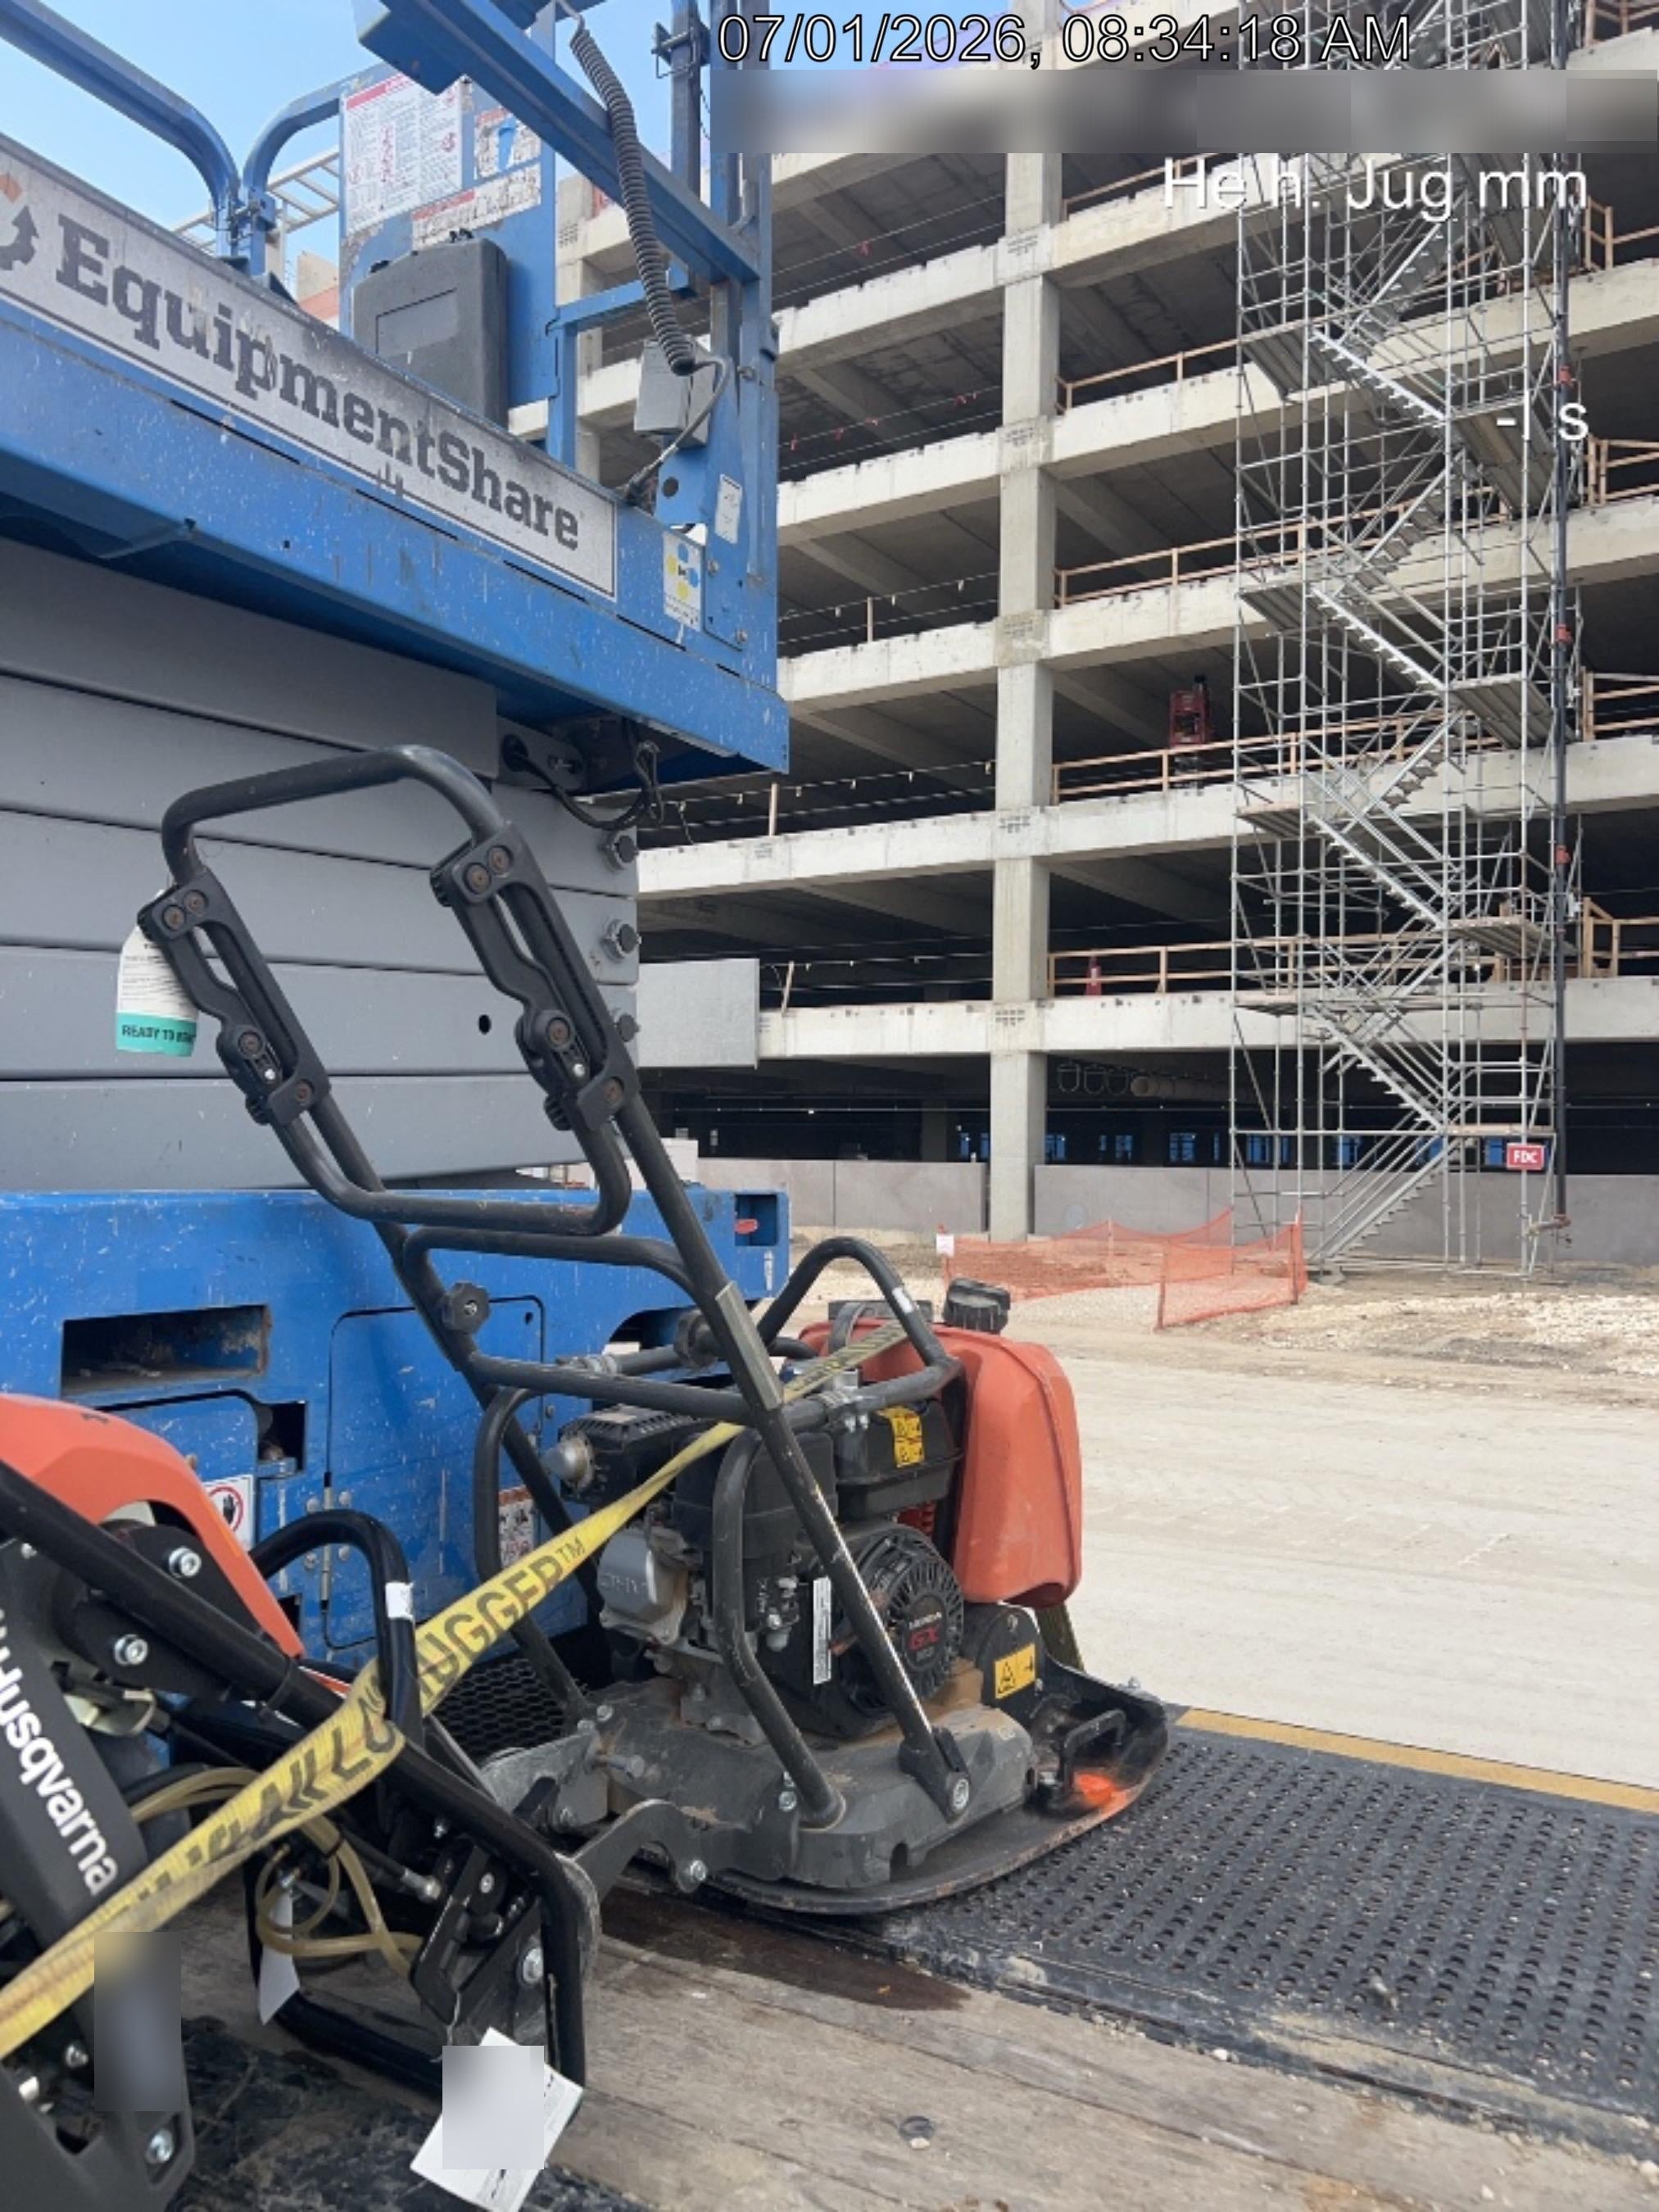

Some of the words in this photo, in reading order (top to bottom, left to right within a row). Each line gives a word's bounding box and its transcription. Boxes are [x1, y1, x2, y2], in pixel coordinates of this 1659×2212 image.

[56, 214, 579, 552] EquipmentShare
[121, 1023, 161, 1040] READY
[1513, 1149, 1537, 1163] FDC
